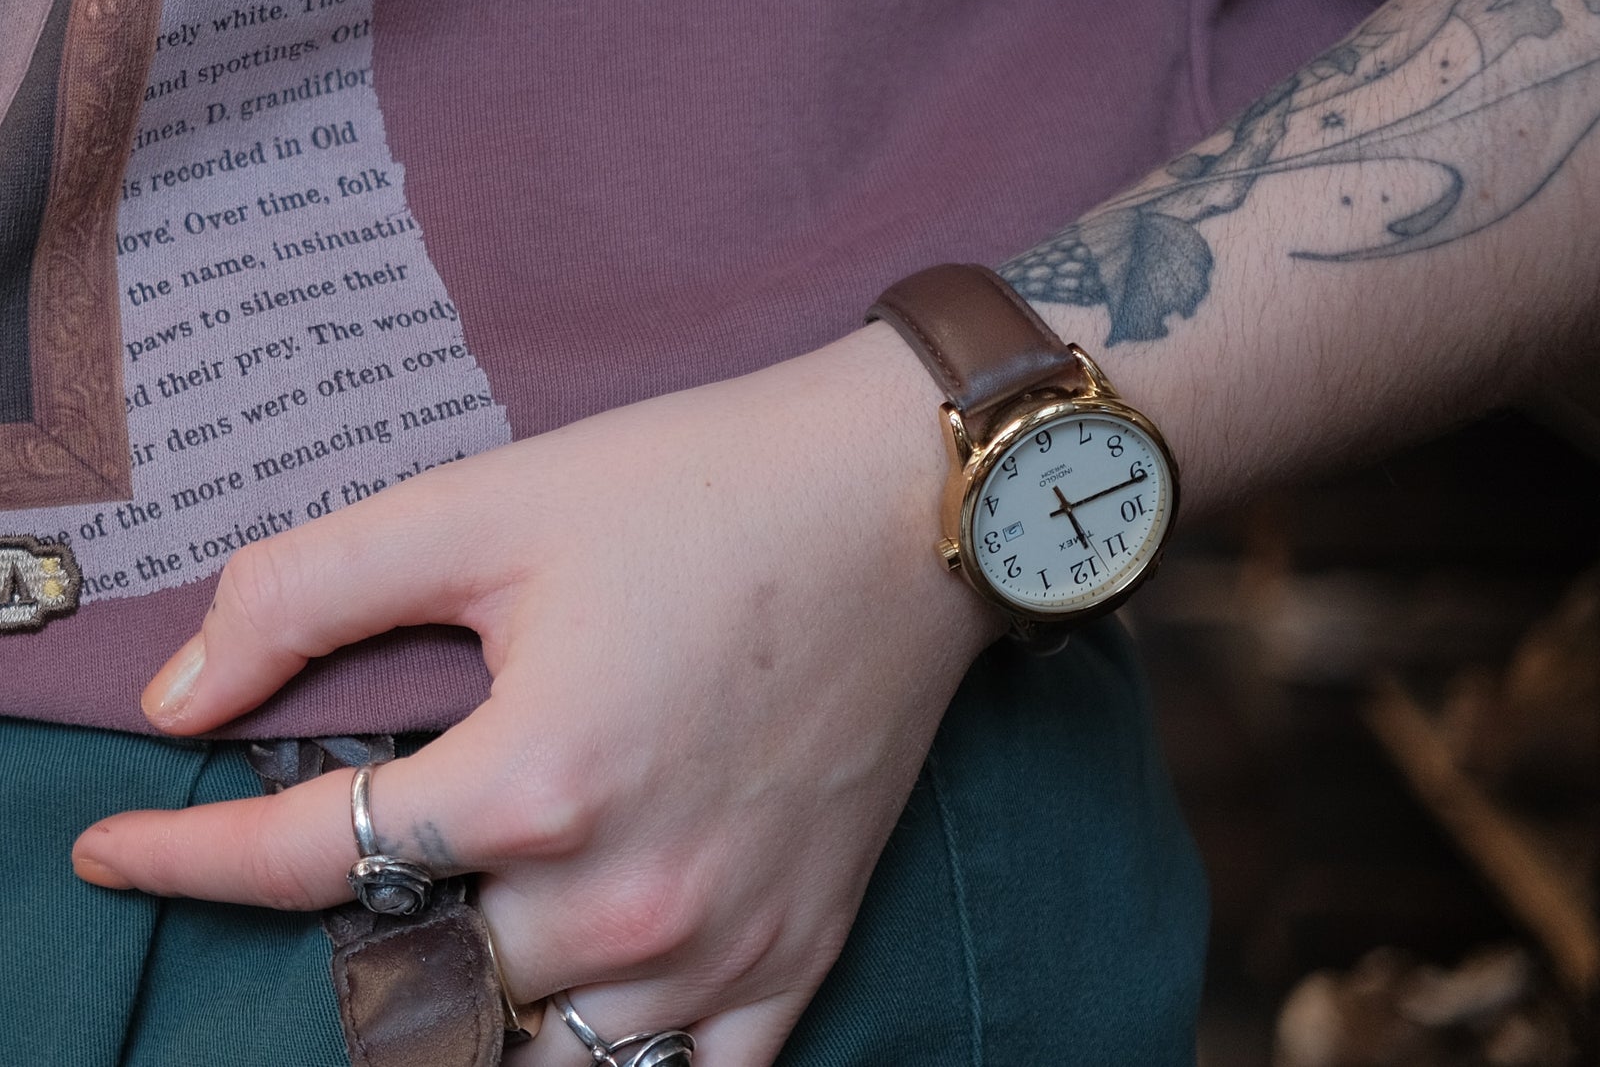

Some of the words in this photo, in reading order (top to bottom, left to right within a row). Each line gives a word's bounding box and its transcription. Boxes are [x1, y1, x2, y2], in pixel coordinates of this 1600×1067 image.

[156, 23, 202, 52] rely
[211, 4, 288, 33] white.
[144, 70, 189, 101] and
[198, 39, 319, 84] spottings.
[206, 103, 231, 125] D.
[151, 142, 267, 192] recorded
[274, 136, 302, 161] in
[312, 121, 359, 150] Old
[184, 203, 249, 235] Over
[257, 188, 330, 218] time,
[337, 168, 393, 198] folk
[127, 278, 173, 306] the
[181, 253, 266, 289] name,
[126, 320, 194, 362] paws
[199, 309, 232, 330] to
[240, 279, 338, 317] silence
[343, 262, 409, 293] their
[157, 359, 225, 399] their
[235, 335, 301, 376] prey.
[308, 320, 365, 346] The
[372, 299, 459, 333] woody
[167, 416, 234, 453] dens
[241, 388, 309, 425] were
[318, 361, 395, 396] often
[1035, 430, 1053, 454] 6
[1077, 422, 1093, 445] 7
[1106, 435, 1125, 458] 8
[79, 512, 107, 541] of
[116, 498, 164, 532] the
[171, 472, 245, 513] more
[252, 418, 393, 483] menacing
[1001, 456, 1019, 480] 5
[1129, 461, 1148, 482] 9
[983, 495, 1000, 518] 4
[1120, 494, 1148, 522] 10
[136, 550, 183, 582] the
[188, 508, 294, 563] toxicity
[306, 491, 331, 520] of
[984, 531, 1002, 554] 3
[1058, 530, 1094, 552] TMEX
[1102, 533, 1130, 558] 11
[1003, 554, 1022, 579] 2
[1070, 556, 1101, 585] 12
[1037, 569, 1053, 592] 1
